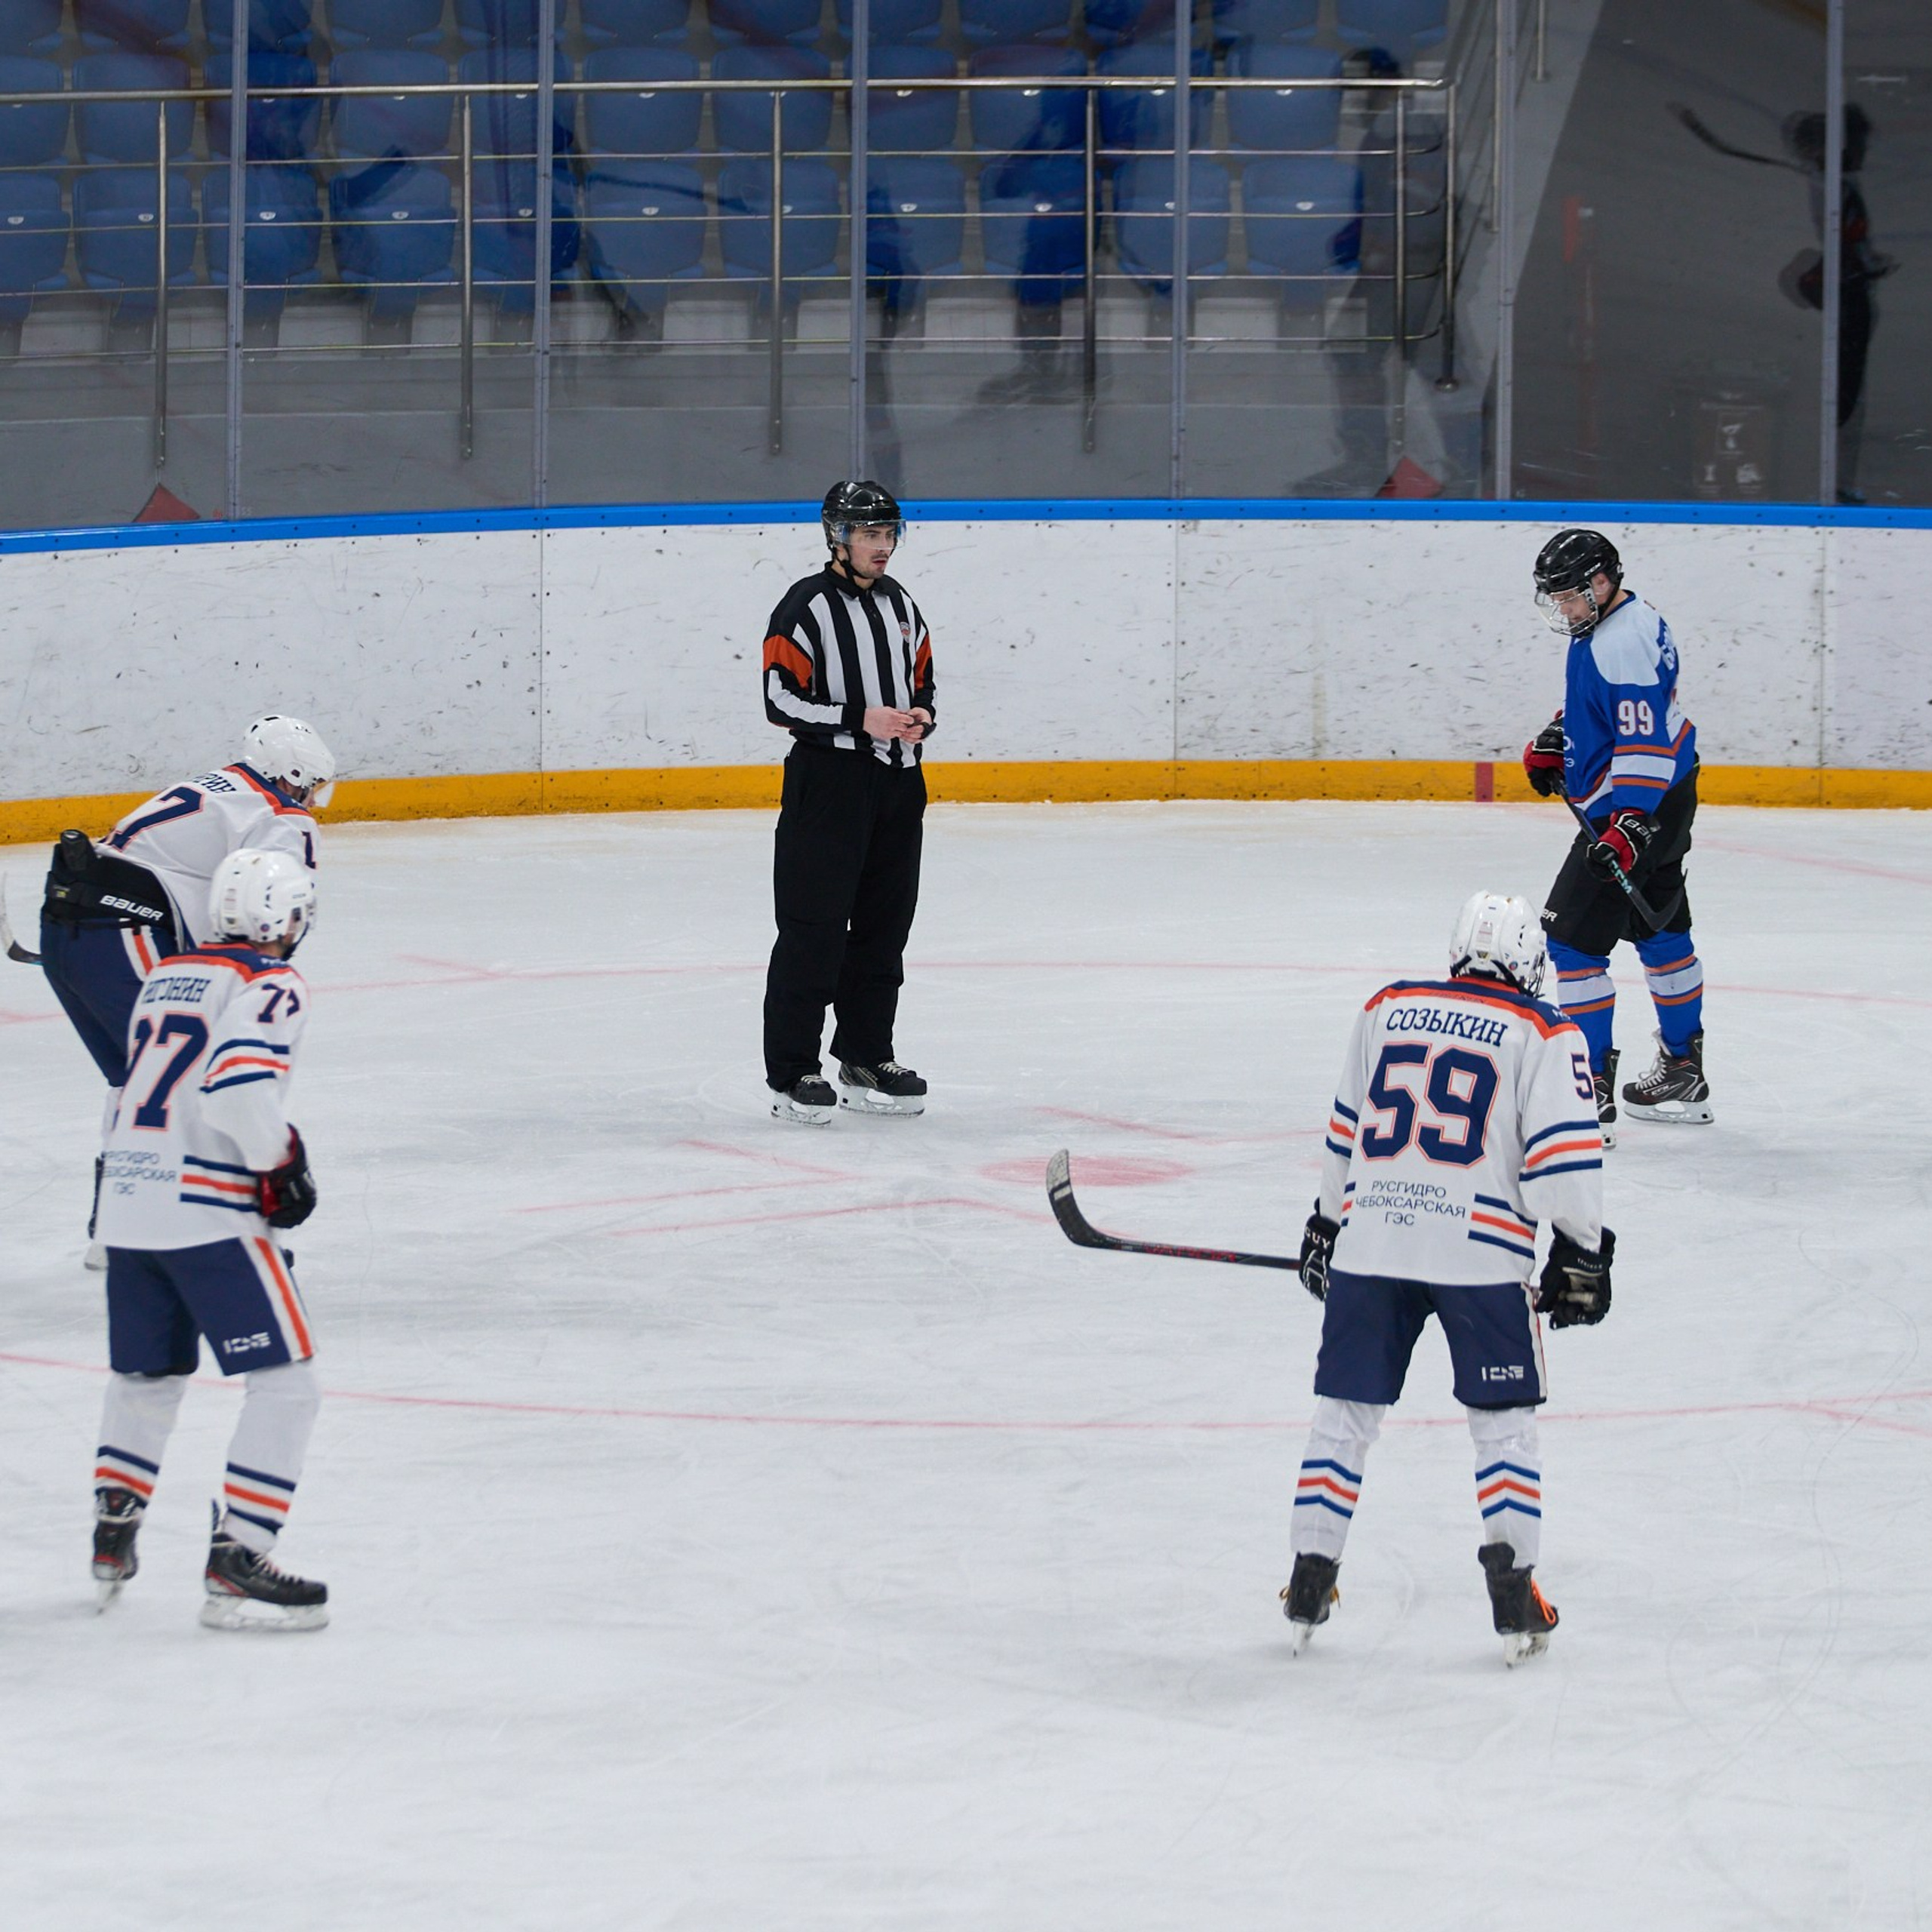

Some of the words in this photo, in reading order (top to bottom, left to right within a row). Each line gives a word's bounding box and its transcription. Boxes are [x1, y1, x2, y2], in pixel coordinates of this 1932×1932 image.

[1618, 700, 1654, 736] 99
[1386, 1008, 1508, 1047] СОЗЫКИН
[1360, 1040, 1500, 1169] 59
[1371, 1180, 1447, 1198] РУСГИДРО
[1355, 1195, 1466, 1218] ЧЕБОКСАРСКАЯ
[1385, 1211, 1415, 1226] ГЭС
